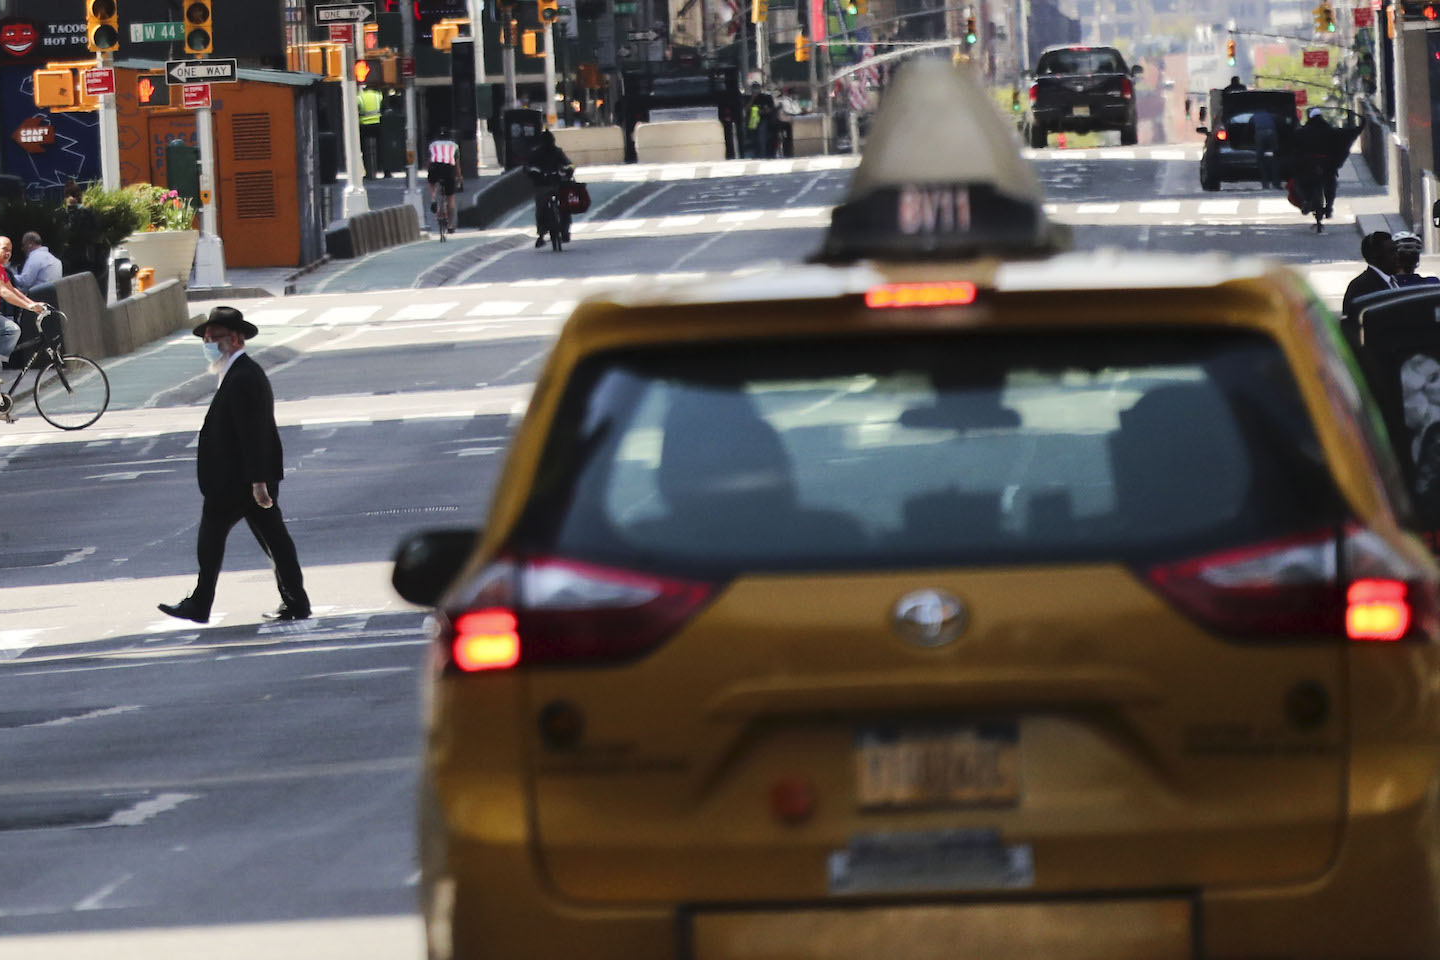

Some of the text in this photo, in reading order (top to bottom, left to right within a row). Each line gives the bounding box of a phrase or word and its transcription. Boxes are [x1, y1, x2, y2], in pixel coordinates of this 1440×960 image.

[324, 9, 366, 19] ONE WAY
[48, 23, 87, 34] TACOS
[145, 26, 156, 39] W
[161, 24, 175, 38] 44
[44, 36, 66, 46] HOT
[70, 36, 88, 45] DO
[177, 66, 228, 77] ONE WAY
[20, 128, 48, 137] CRAFT
[21, 135, 43, 143] BEER
